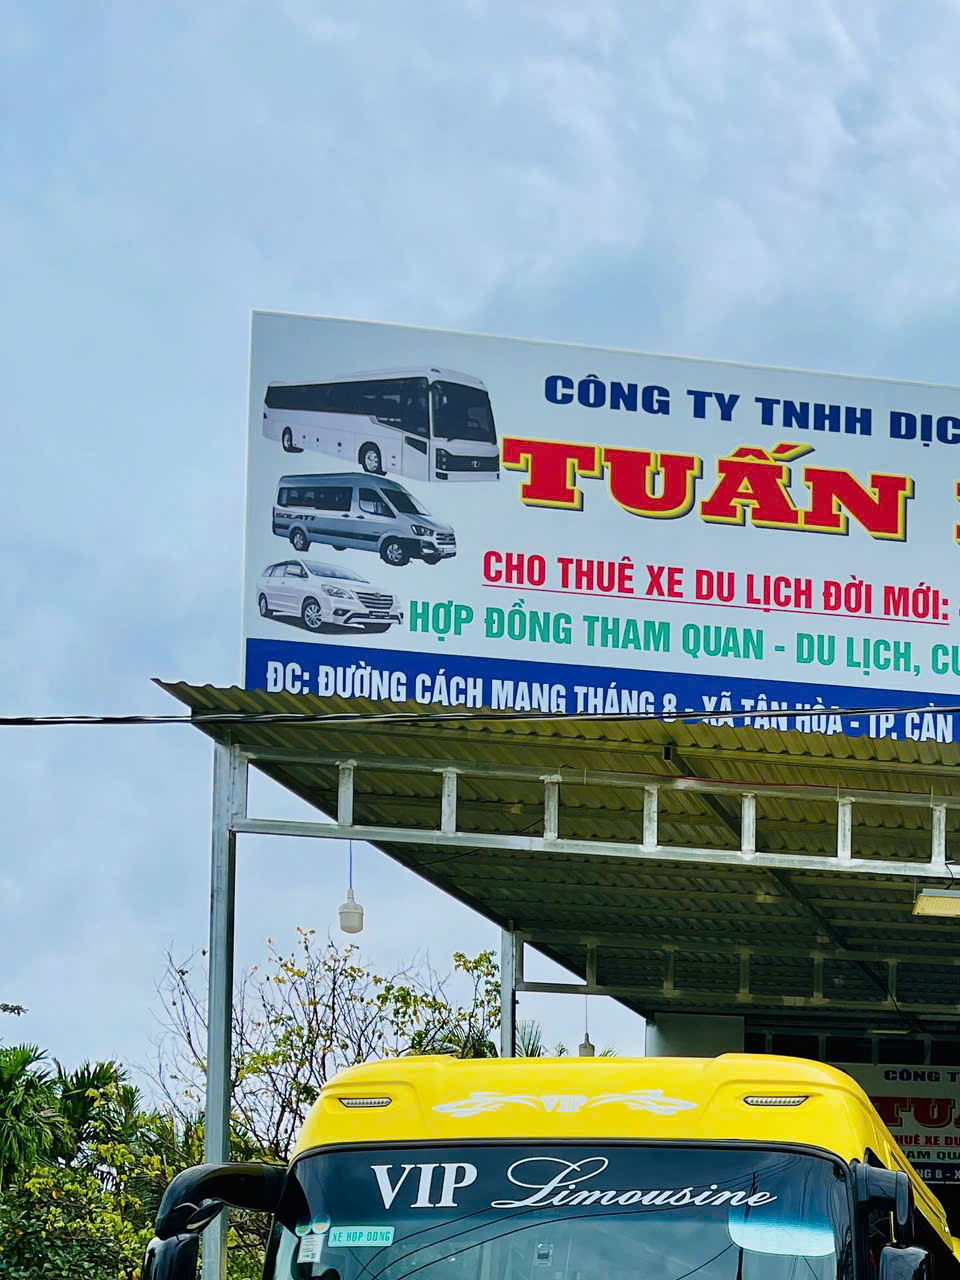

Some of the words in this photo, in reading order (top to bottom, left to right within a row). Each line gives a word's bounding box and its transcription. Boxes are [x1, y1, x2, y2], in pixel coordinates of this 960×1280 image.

[544, 374, 671, 415] CÔNG
[686, 389, 741, 422] TY
[754, 396, 872, 436] TNHH
[275, 512, 316, 521] SOLATI
[502, 436, 914, 543] TUẤN
[483, 550, 546, 586] CHO
[557, 556, 634, 594] THUÊ
[645, 565, 684, 598] XE
[696, 569, 735, 603] DU
[746, 574, 813, 613] LỊCH
[822, 575, 872, 614] ĐỜI
[883, 582, 949, 621] MỚI:
[410, 599, 474, 643] HỢP
[484, 599, 572, 644] ĐỒNG
[583, 615, 671, 652] THAM
[682, 623, 764, 660] QUAN
[796, 632, 835, 666] DU
[846, 636, 920, 676] LỊCH,
[266, 660, 310, 694] ĐC:
[317, 660, 407, 702] ĐƯỜNG
[415, 669, 483, 708] CÁCH
[573, 682, 655, 717] THÁNG
[662, 692, 677, 723] 8
[702, 691, 734, 727] XÃ
[741, 693, 788, 731] TÂN
[795, 697, 843, 735] HÒA
[884, 1068, 940, 1082] CÔNG
[540, 1095, 588, 1112] VIP
[924, 1135, 941, 1146] XE
[370, 1162, 478, 1210] VIP
[491, 1156, 777, 1209] Limousine
[332, 1231, 343, 1242] XE
